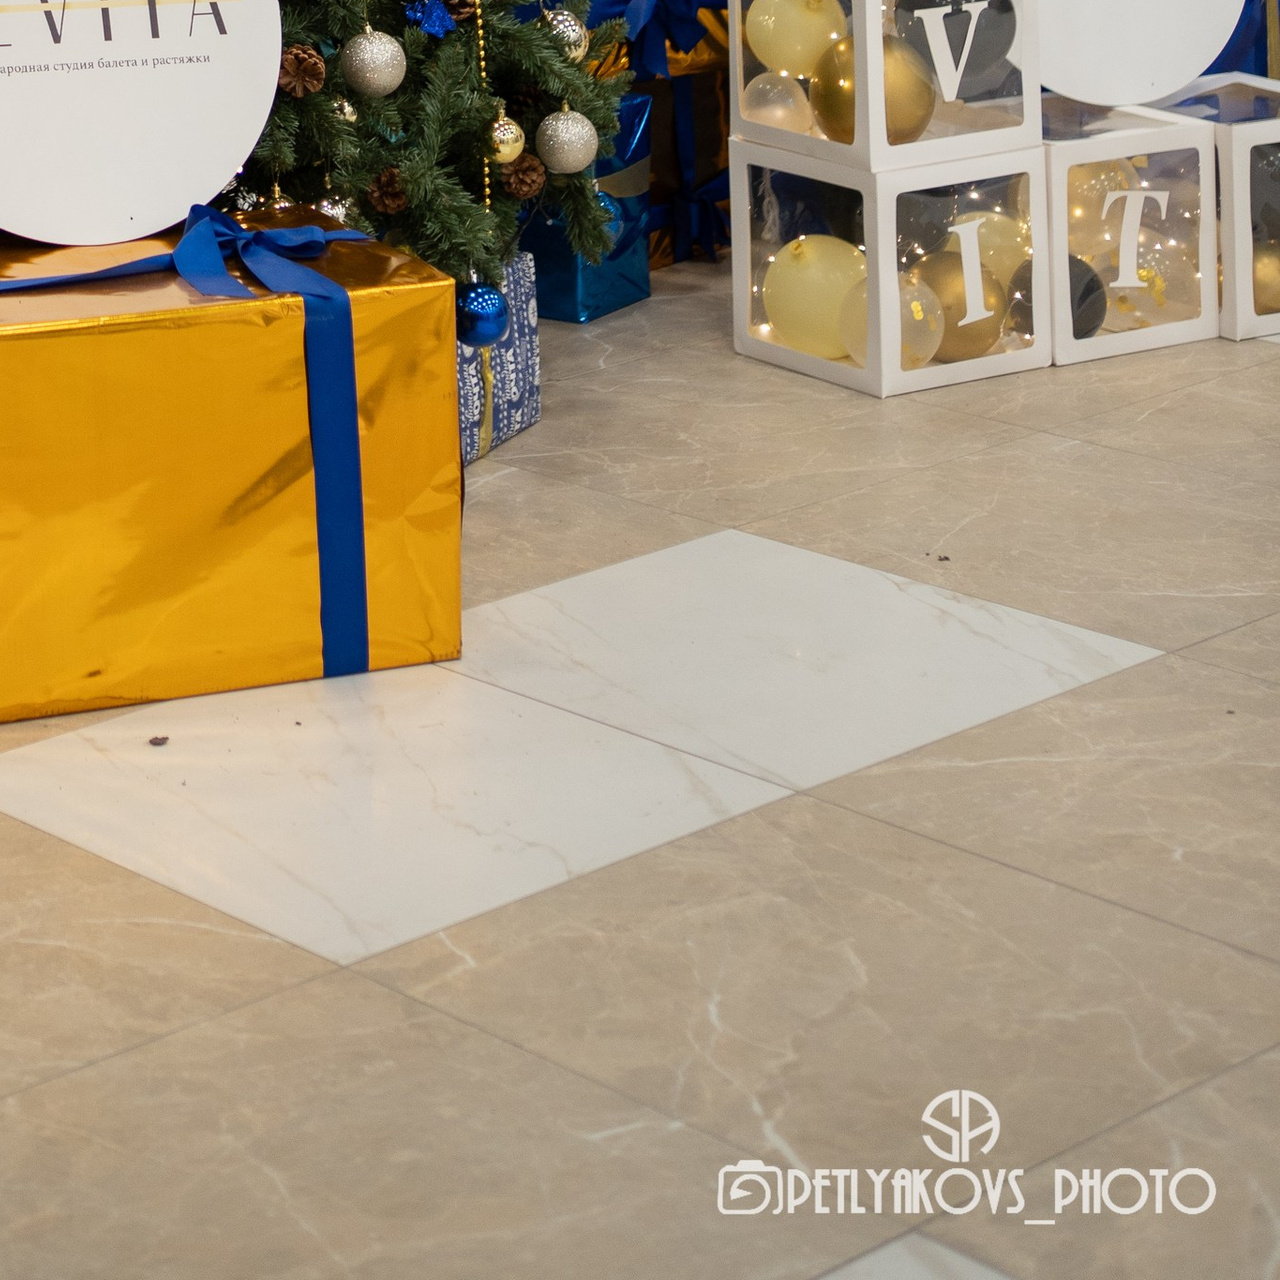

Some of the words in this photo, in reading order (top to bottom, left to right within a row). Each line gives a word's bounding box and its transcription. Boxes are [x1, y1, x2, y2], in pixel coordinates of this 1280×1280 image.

[53, 60, 95, 73] студия
[97, 57, 138, 69] балета
[141, 58, 149, 67] и
[152, 53, 211, 69] растяжки
[914, 1, 990, 102] V
[947, 218, 995, 328] I
[1101, 191, 1169, 288] T
